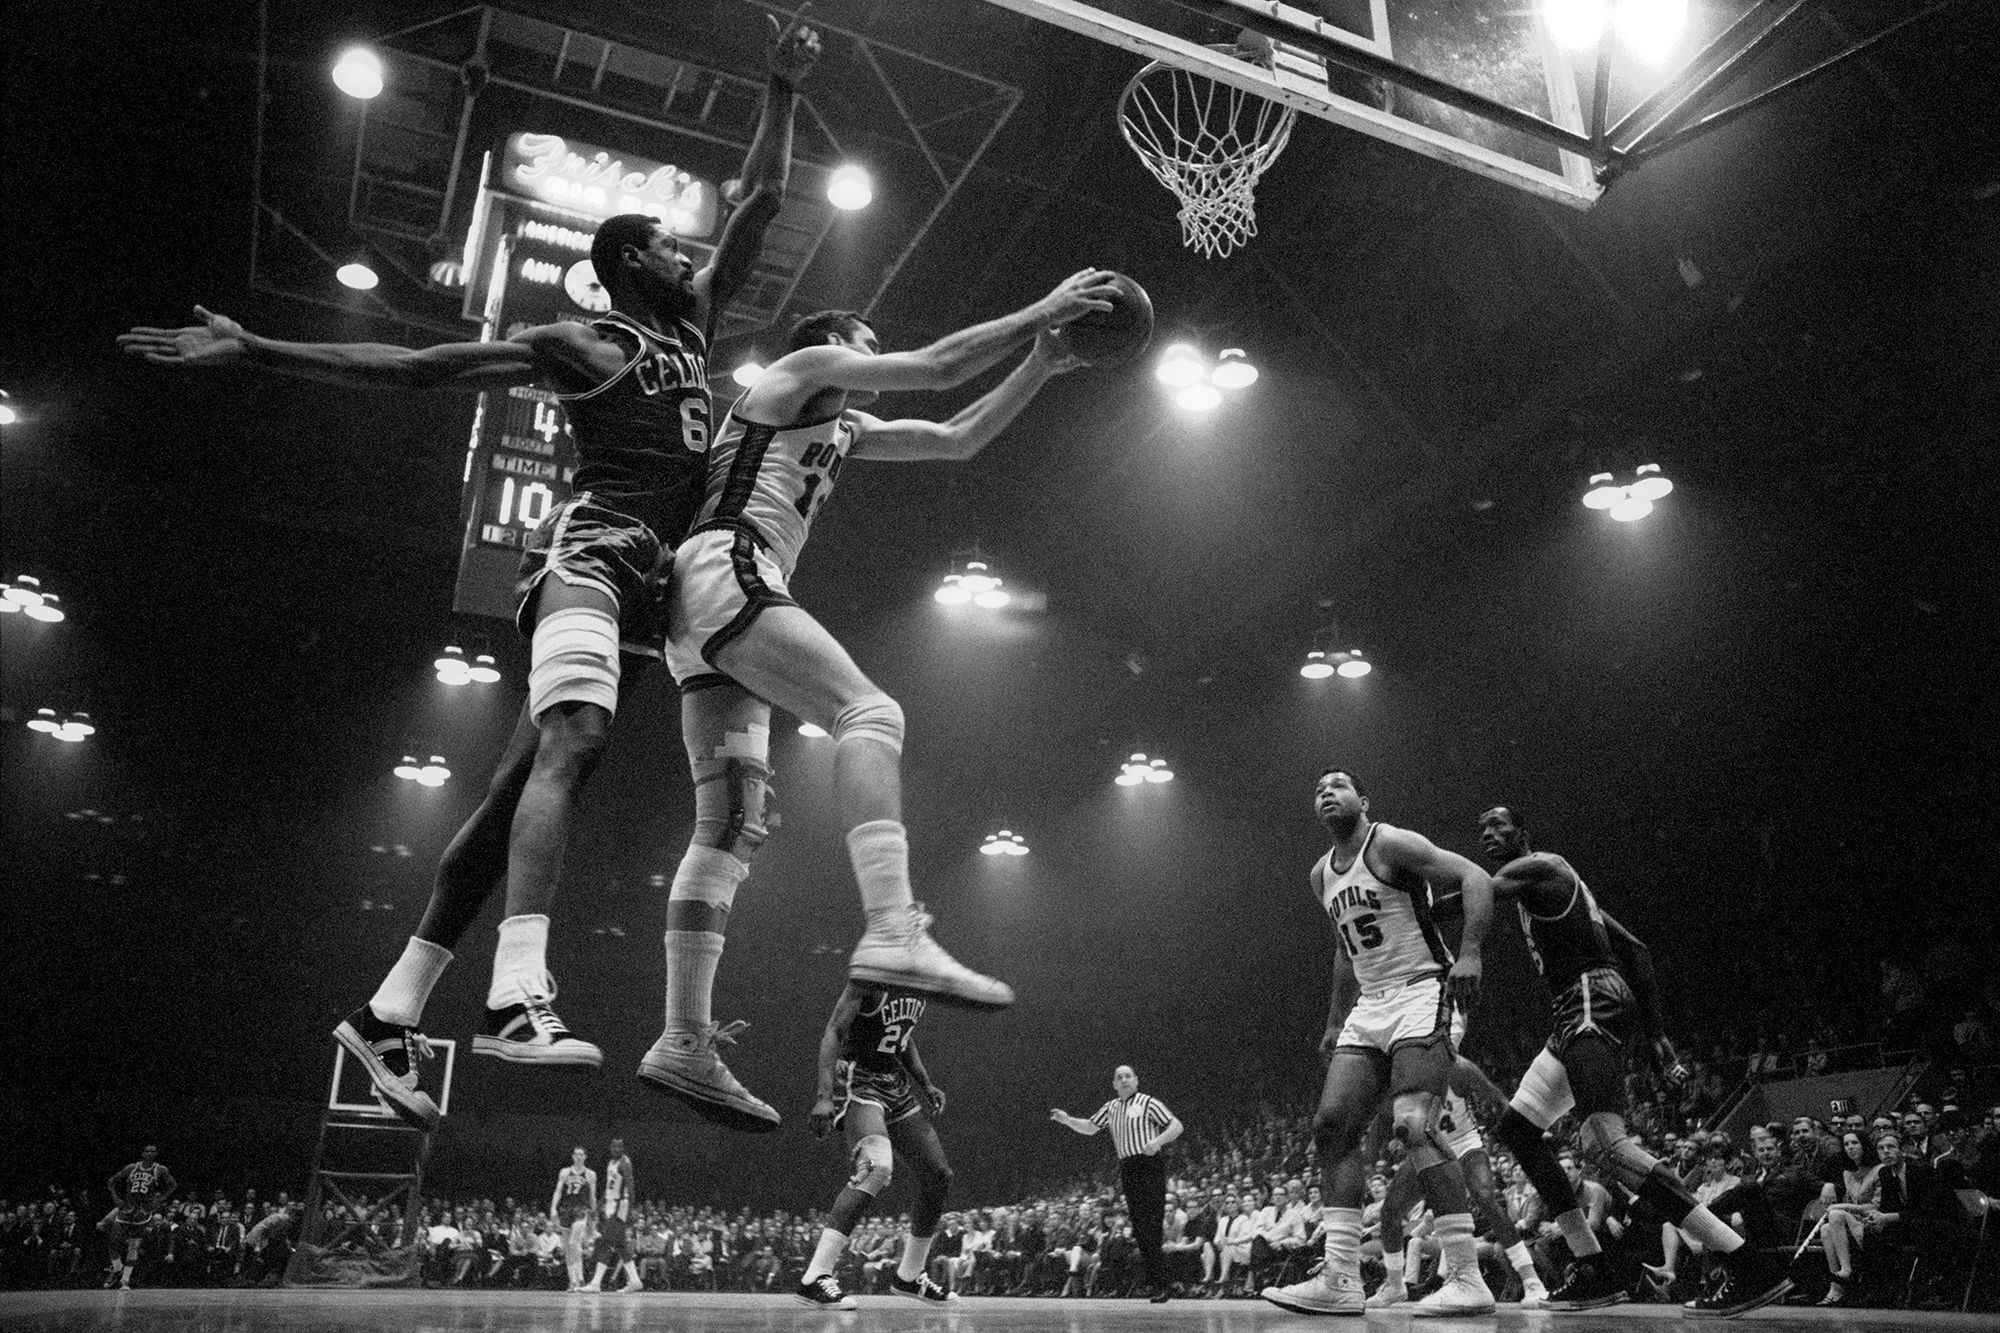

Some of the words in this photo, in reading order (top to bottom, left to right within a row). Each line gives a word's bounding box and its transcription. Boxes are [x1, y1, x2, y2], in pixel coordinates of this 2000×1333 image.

[516, 133, 701, 211] Frisch's
[533, 401, 559, 443] 4
[679, 397, 709, 454] 6
[500, 456, 553, 477] TIME
[499, 476, 554, 530] 10
[793, 470, 826, 520] 1
[1340, 913, 1384, 956] 15
[131, 1181, 149, 1194] 25
[567, 1183, 582, 1195] 17
